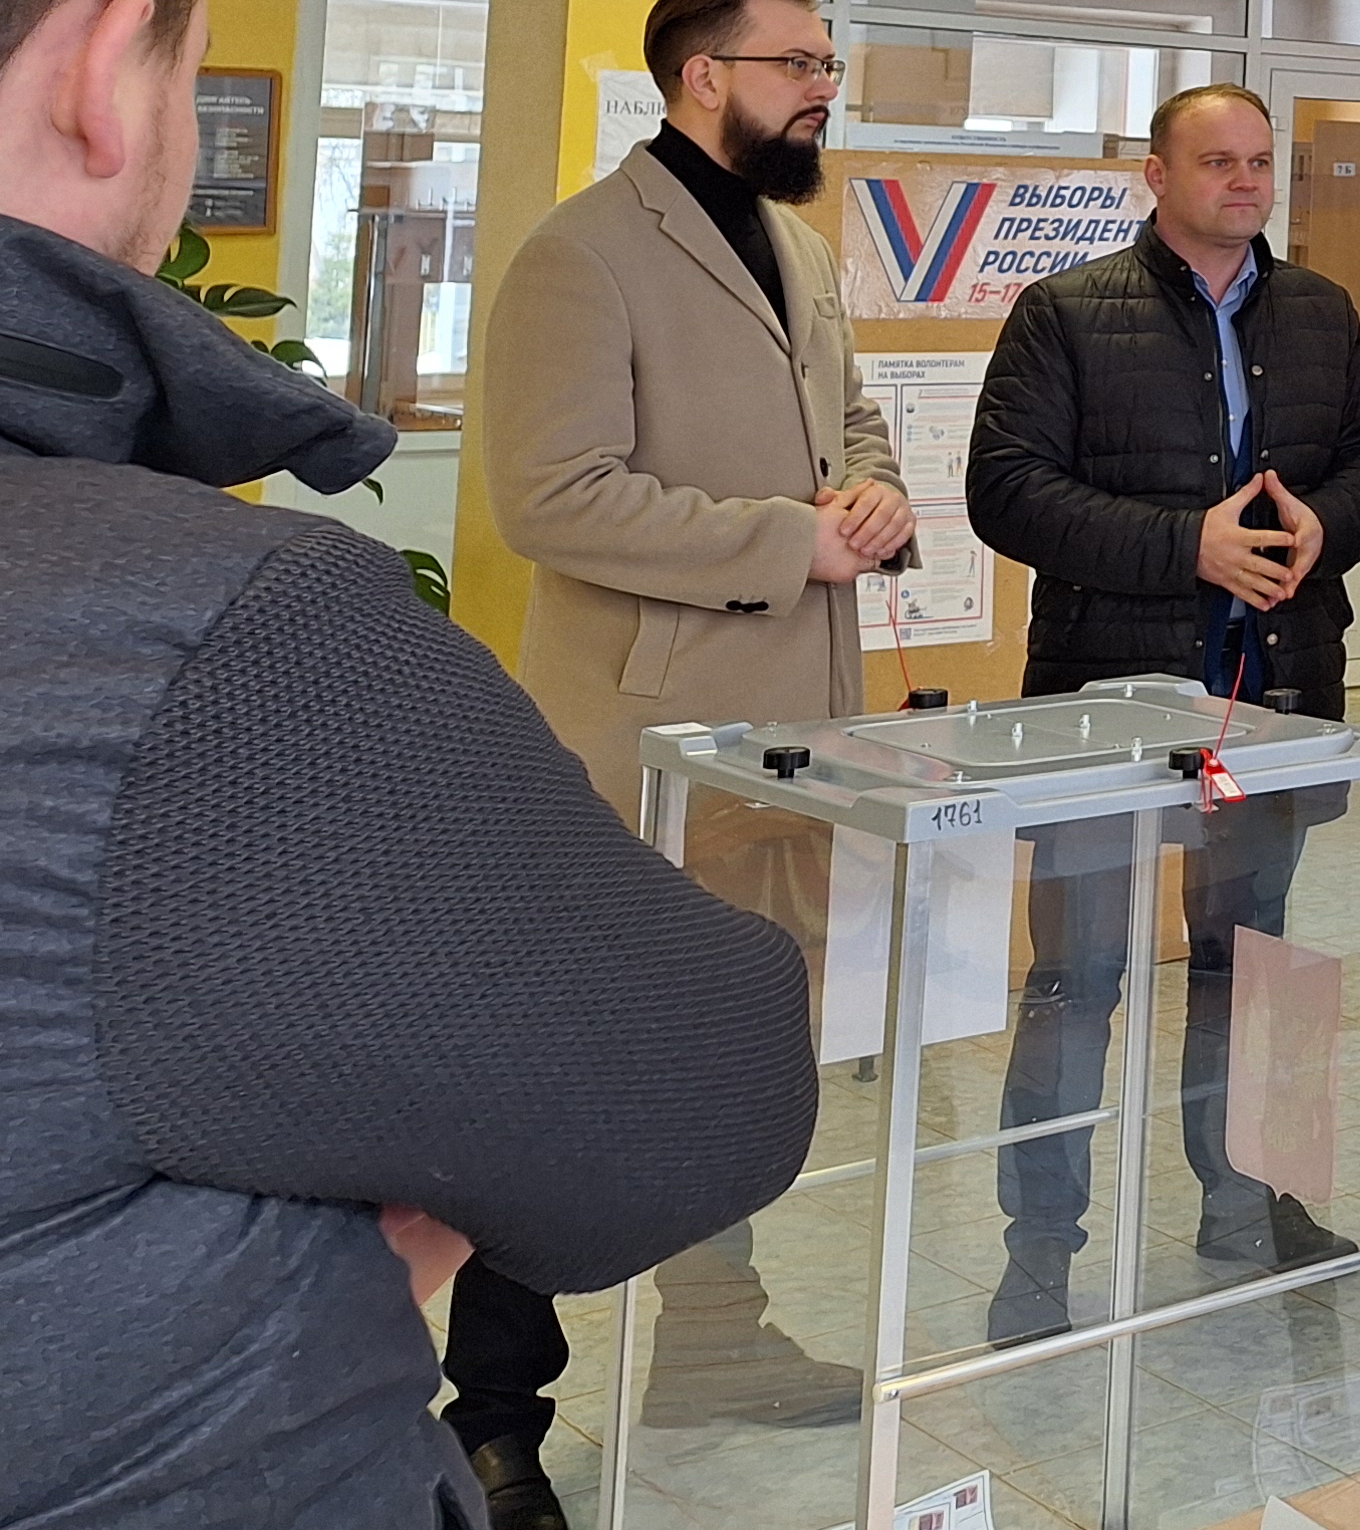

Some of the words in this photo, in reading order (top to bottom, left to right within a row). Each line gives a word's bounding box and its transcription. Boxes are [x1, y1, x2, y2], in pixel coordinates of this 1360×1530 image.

[1008, 183, 1128, 210] ВЫБОРЫ
[878, 359, 914, 369] ПАМЯТКА
[915, 359, 965, 368] ВОЛОНТЕРАМ
[878, 371, 888, 379] НА
[890, 371, 926, 379] ВЫБОРАХ
[931, 799, 982, 831] 1761
